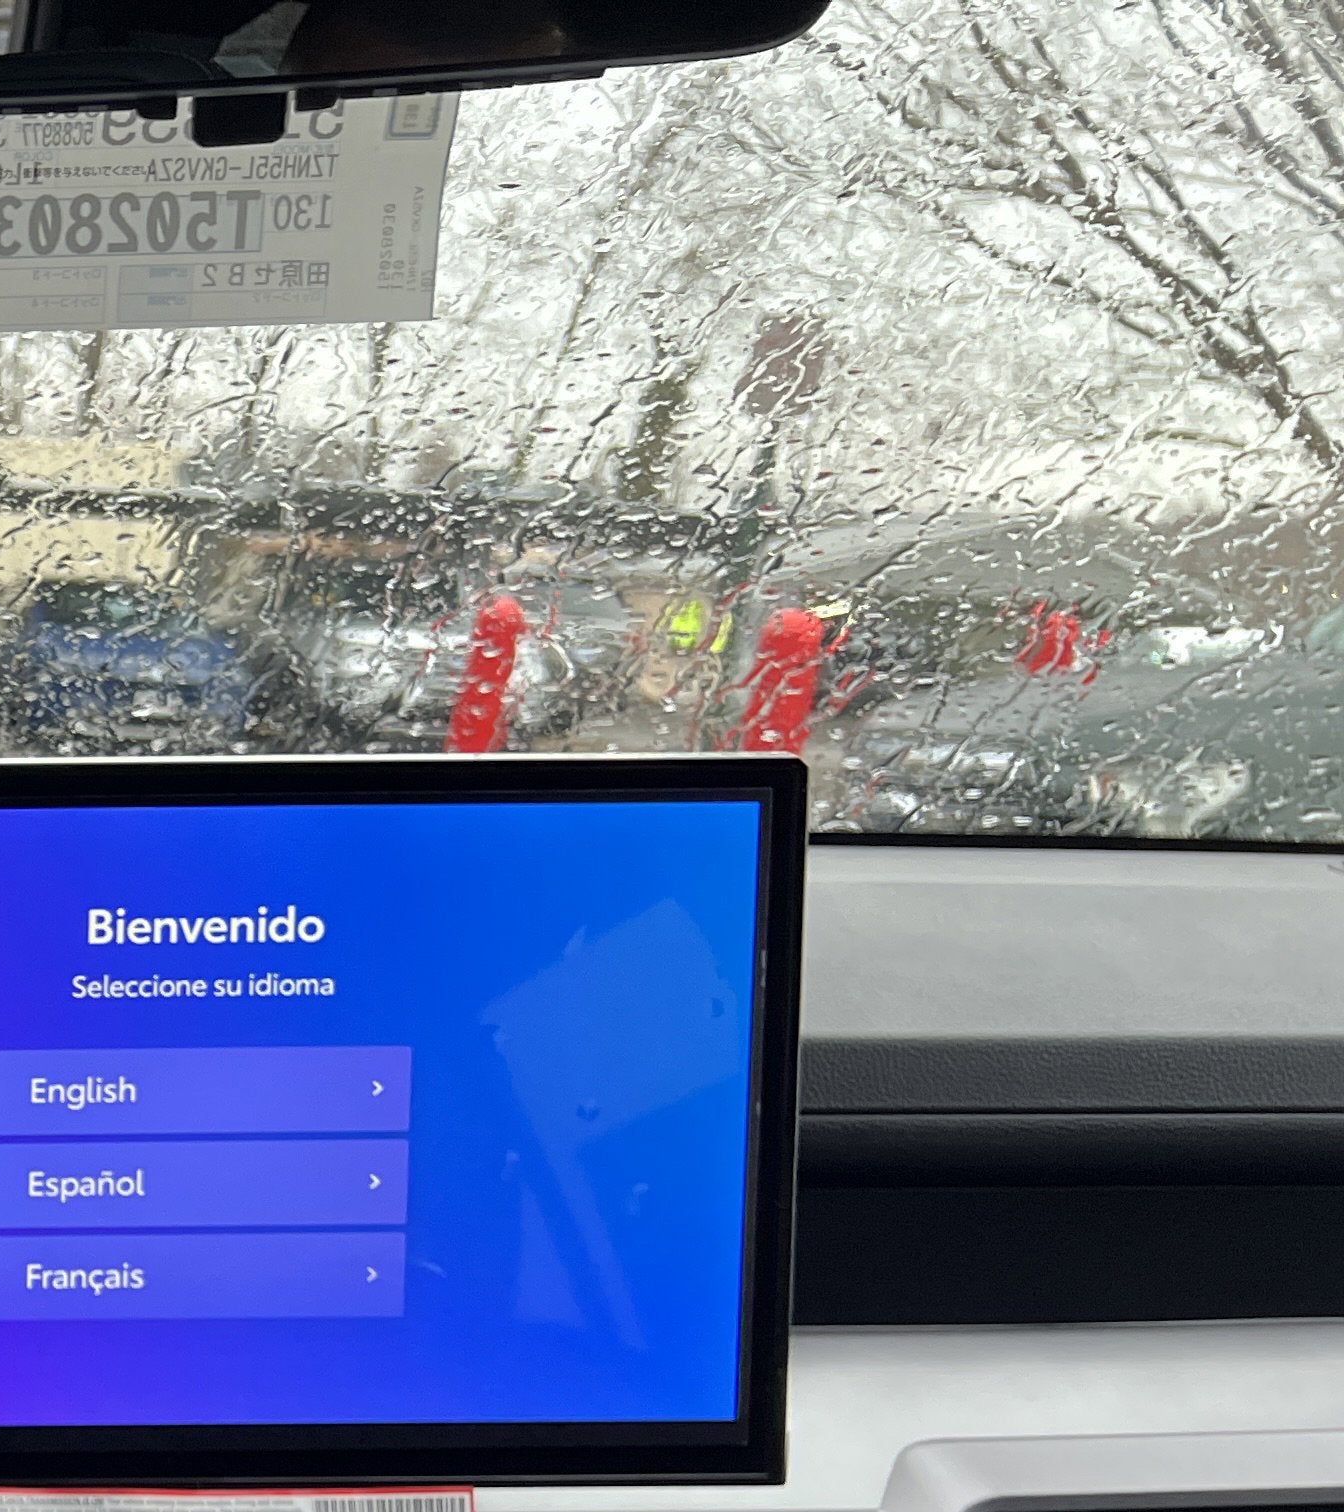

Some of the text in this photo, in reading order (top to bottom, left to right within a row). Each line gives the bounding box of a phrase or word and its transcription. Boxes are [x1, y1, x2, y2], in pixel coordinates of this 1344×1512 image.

[87, 904, 326, 945] Bienvenido
[71, 973, 336, 999] Seleccione su idioma
[30, 1077, 137, 1110] English
[28, 1169, 145, 1202] Español
[26, 1262, 145, 1296] Français
